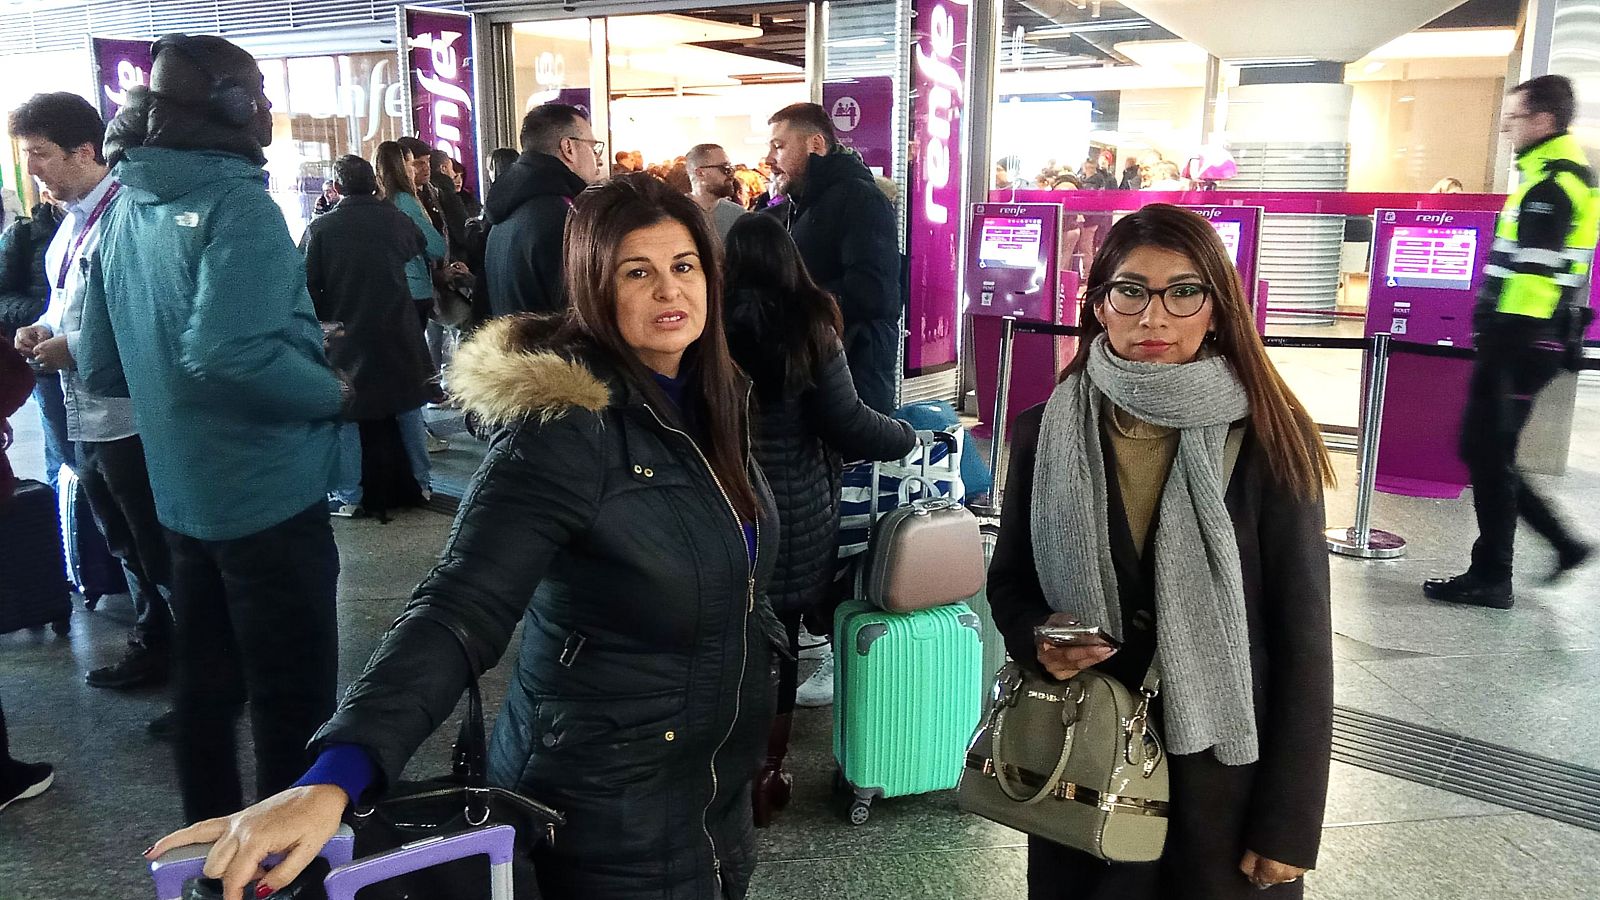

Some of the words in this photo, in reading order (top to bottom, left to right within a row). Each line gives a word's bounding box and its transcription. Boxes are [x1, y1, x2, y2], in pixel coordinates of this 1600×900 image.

[915, 4, 963, 224] renfe
[1000, 206, 1027, 217] renfe
[1415, 212, 1454, 226] renfe
